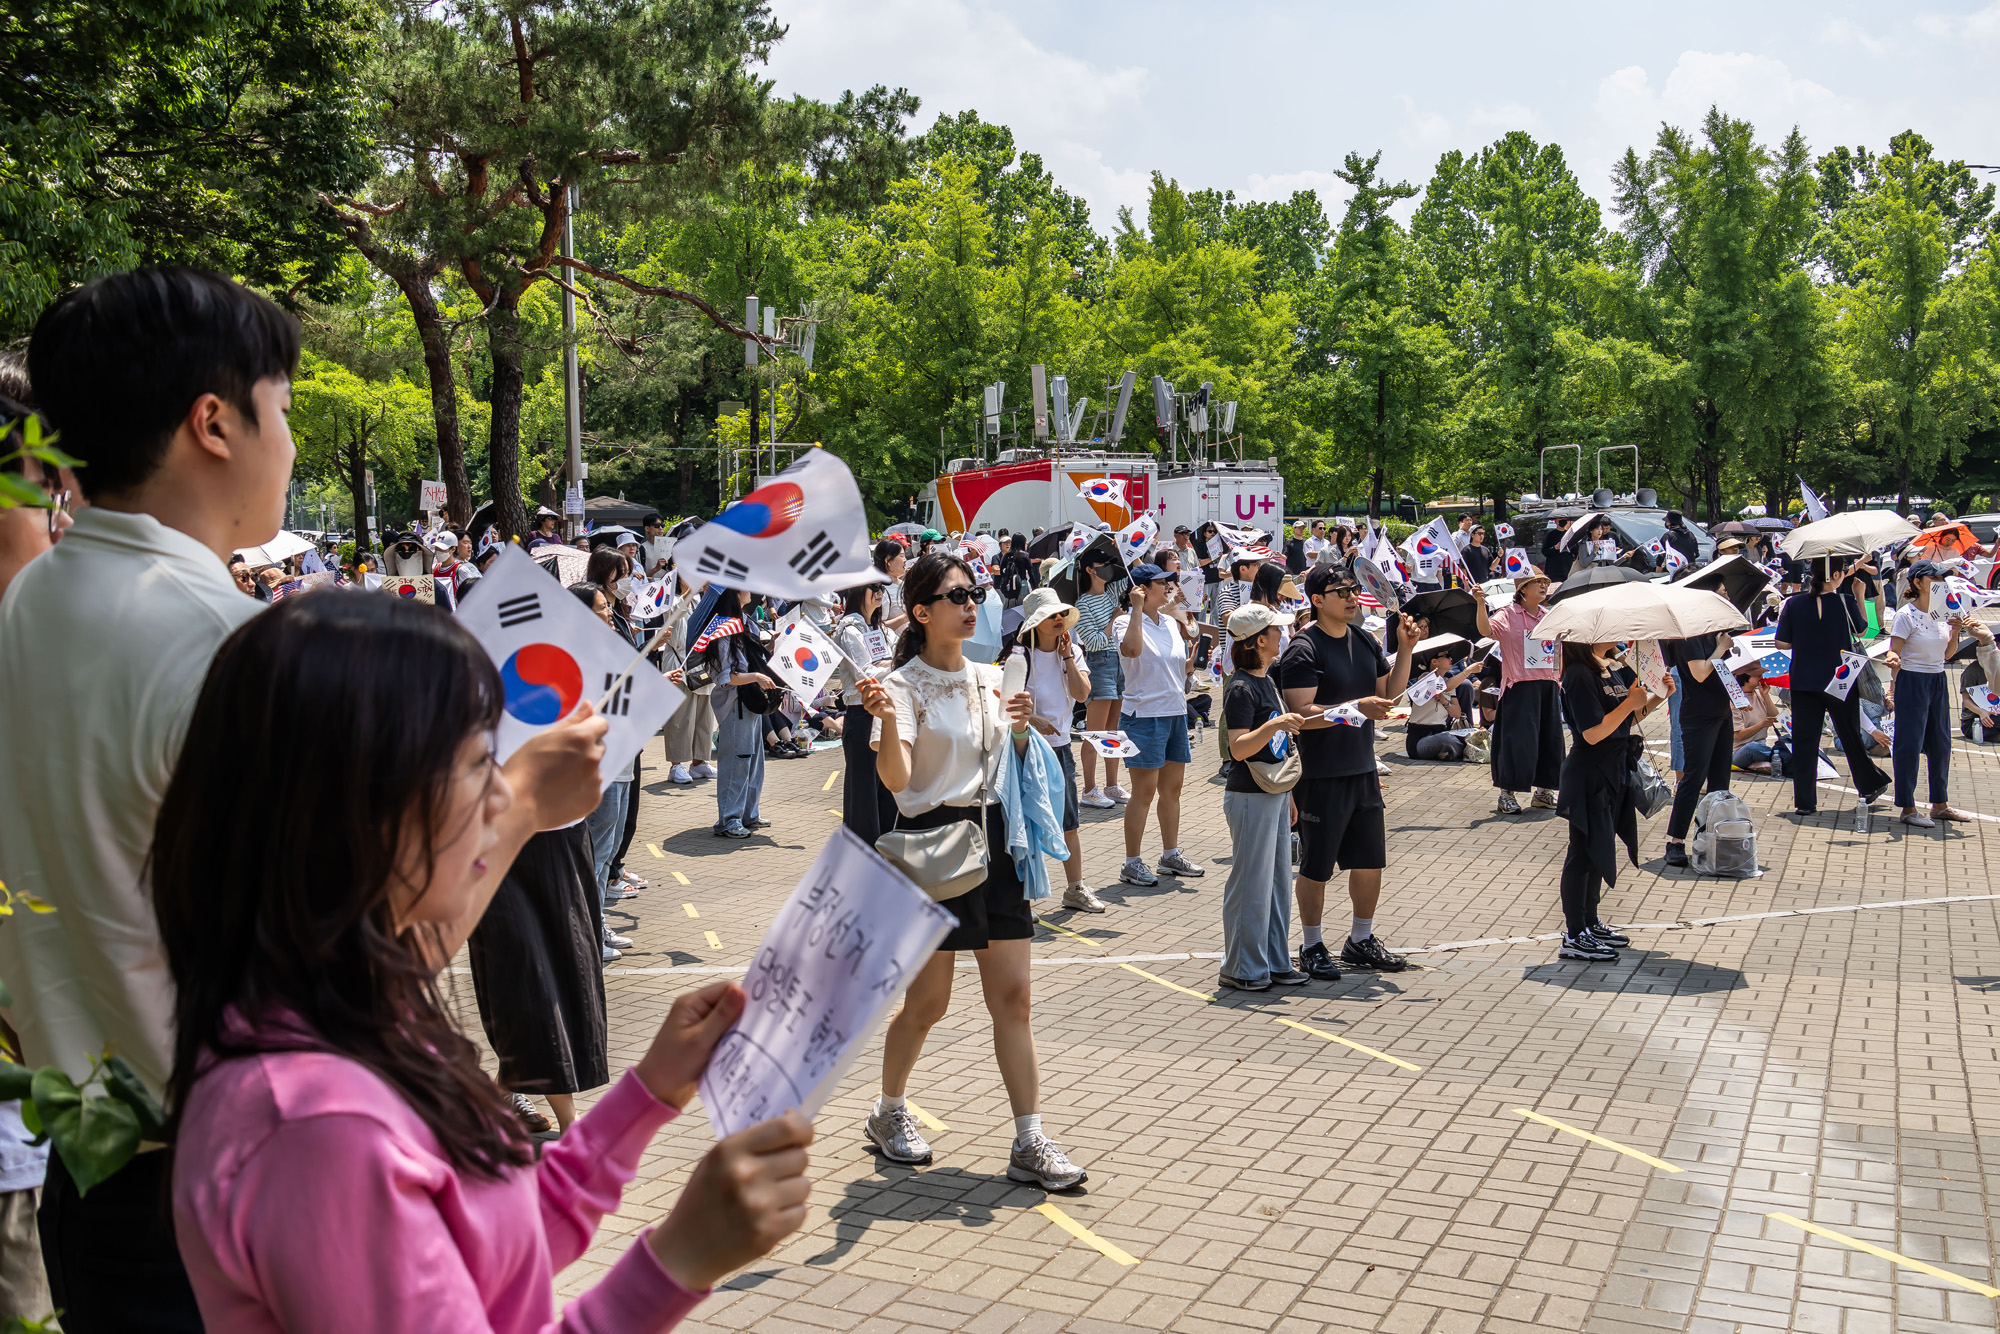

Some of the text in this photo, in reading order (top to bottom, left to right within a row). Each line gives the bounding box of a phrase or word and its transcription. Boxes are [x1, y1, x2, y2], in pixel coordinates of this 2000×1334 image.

[1235, 494, 1275, 520] U+
[417, 586, 433, 594] STEAL
[751, 946, 814, 1034] 당일투표
